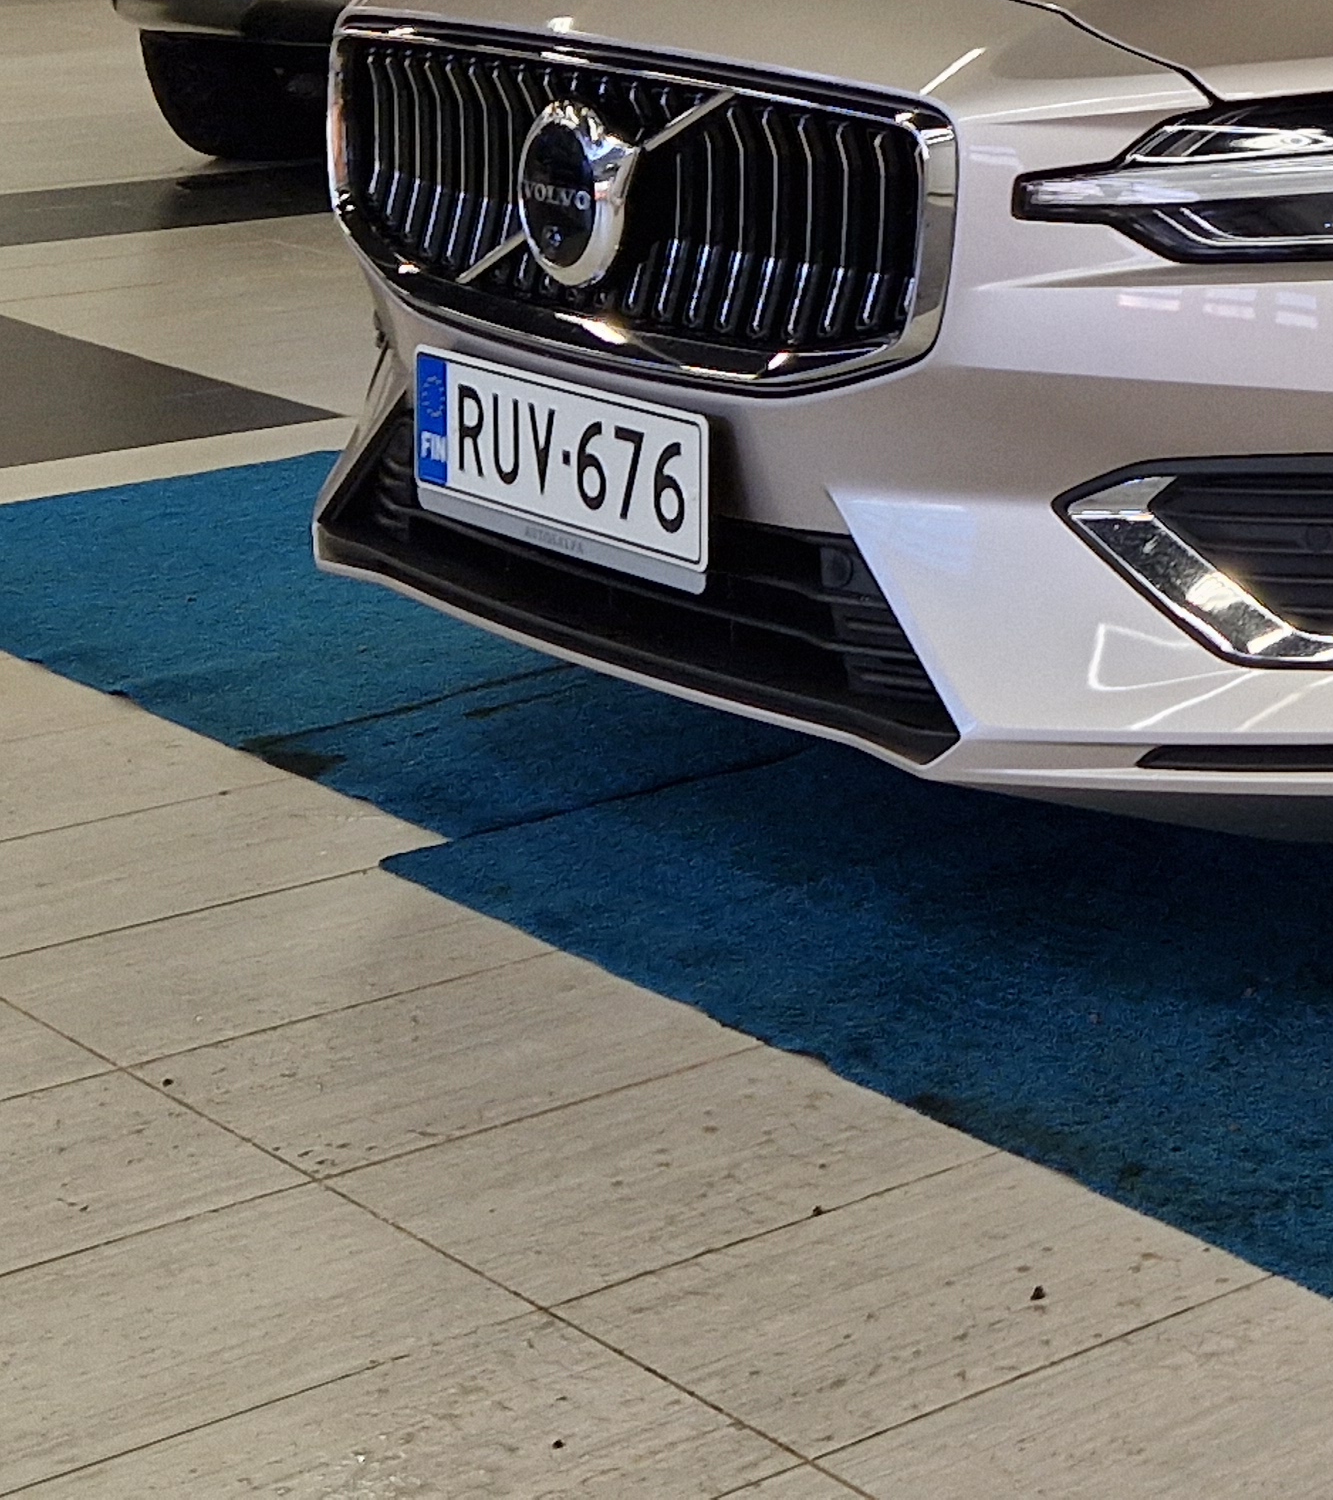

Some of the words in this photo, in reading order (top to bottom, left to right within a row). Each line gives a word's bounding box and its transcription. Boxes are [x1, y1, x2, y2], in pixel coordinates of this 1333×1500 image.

[523, 181, 592, 211] VOLVO
[420, 430, 448, 463] FIN
[457, 383, 685, 533] RUV-676
